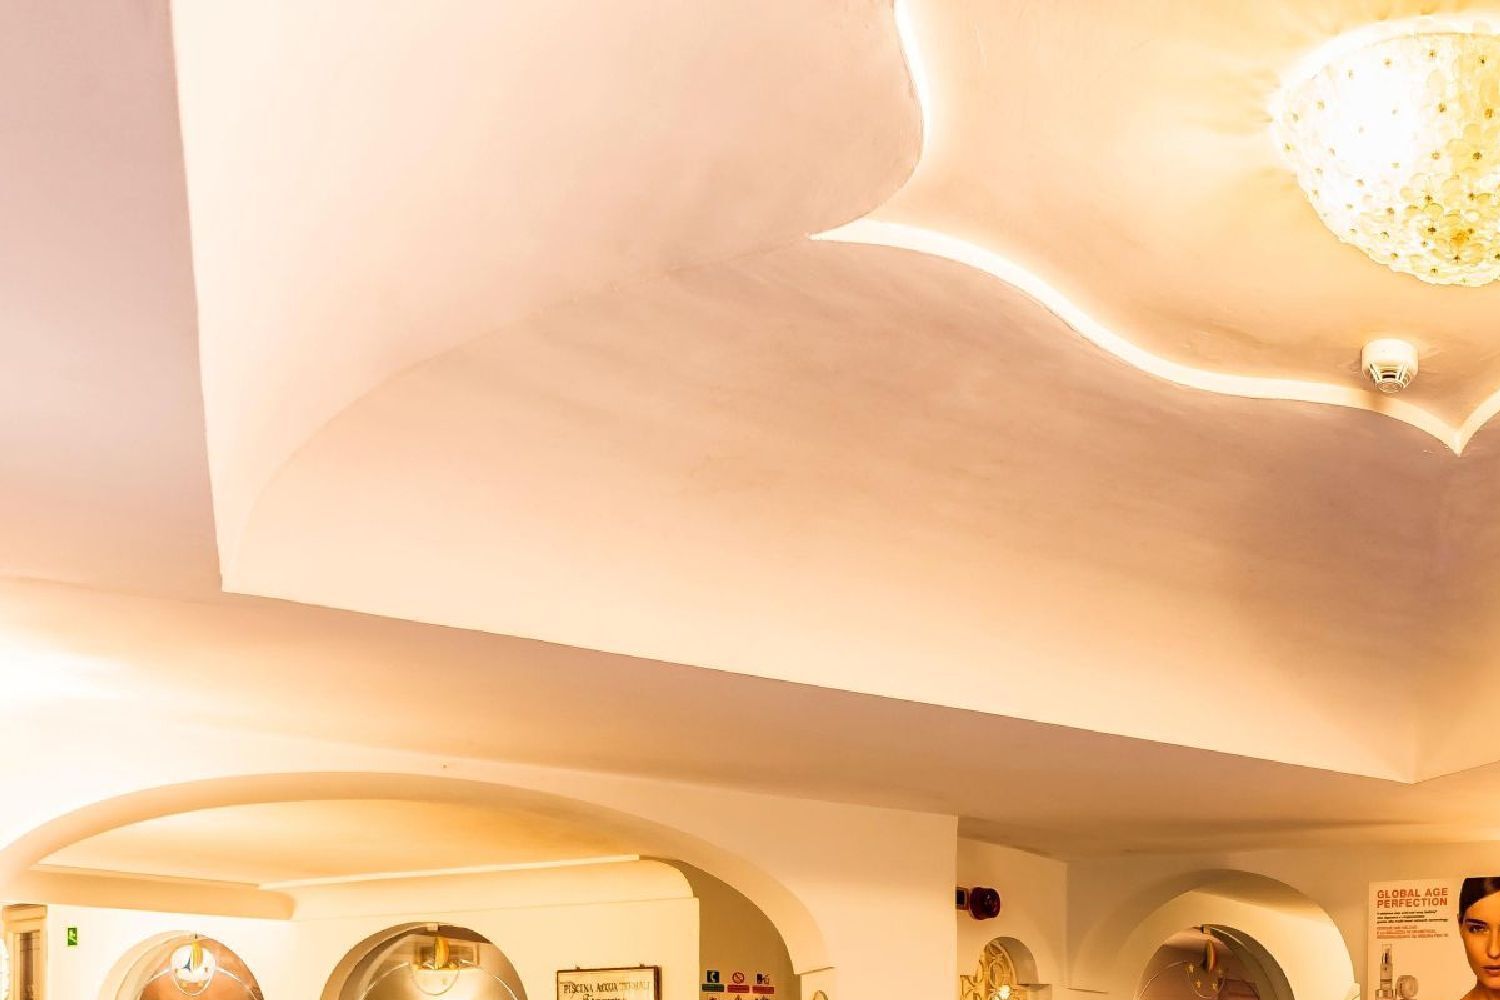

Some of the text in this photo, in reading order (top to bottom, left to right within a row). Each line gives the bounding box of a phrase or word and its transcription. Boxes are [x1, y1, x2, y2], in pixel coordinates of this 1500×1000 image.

[1377, 887, 1448, 899] GLOBAL AGE
[1377, 897, 1448, 909] PERFECTION
